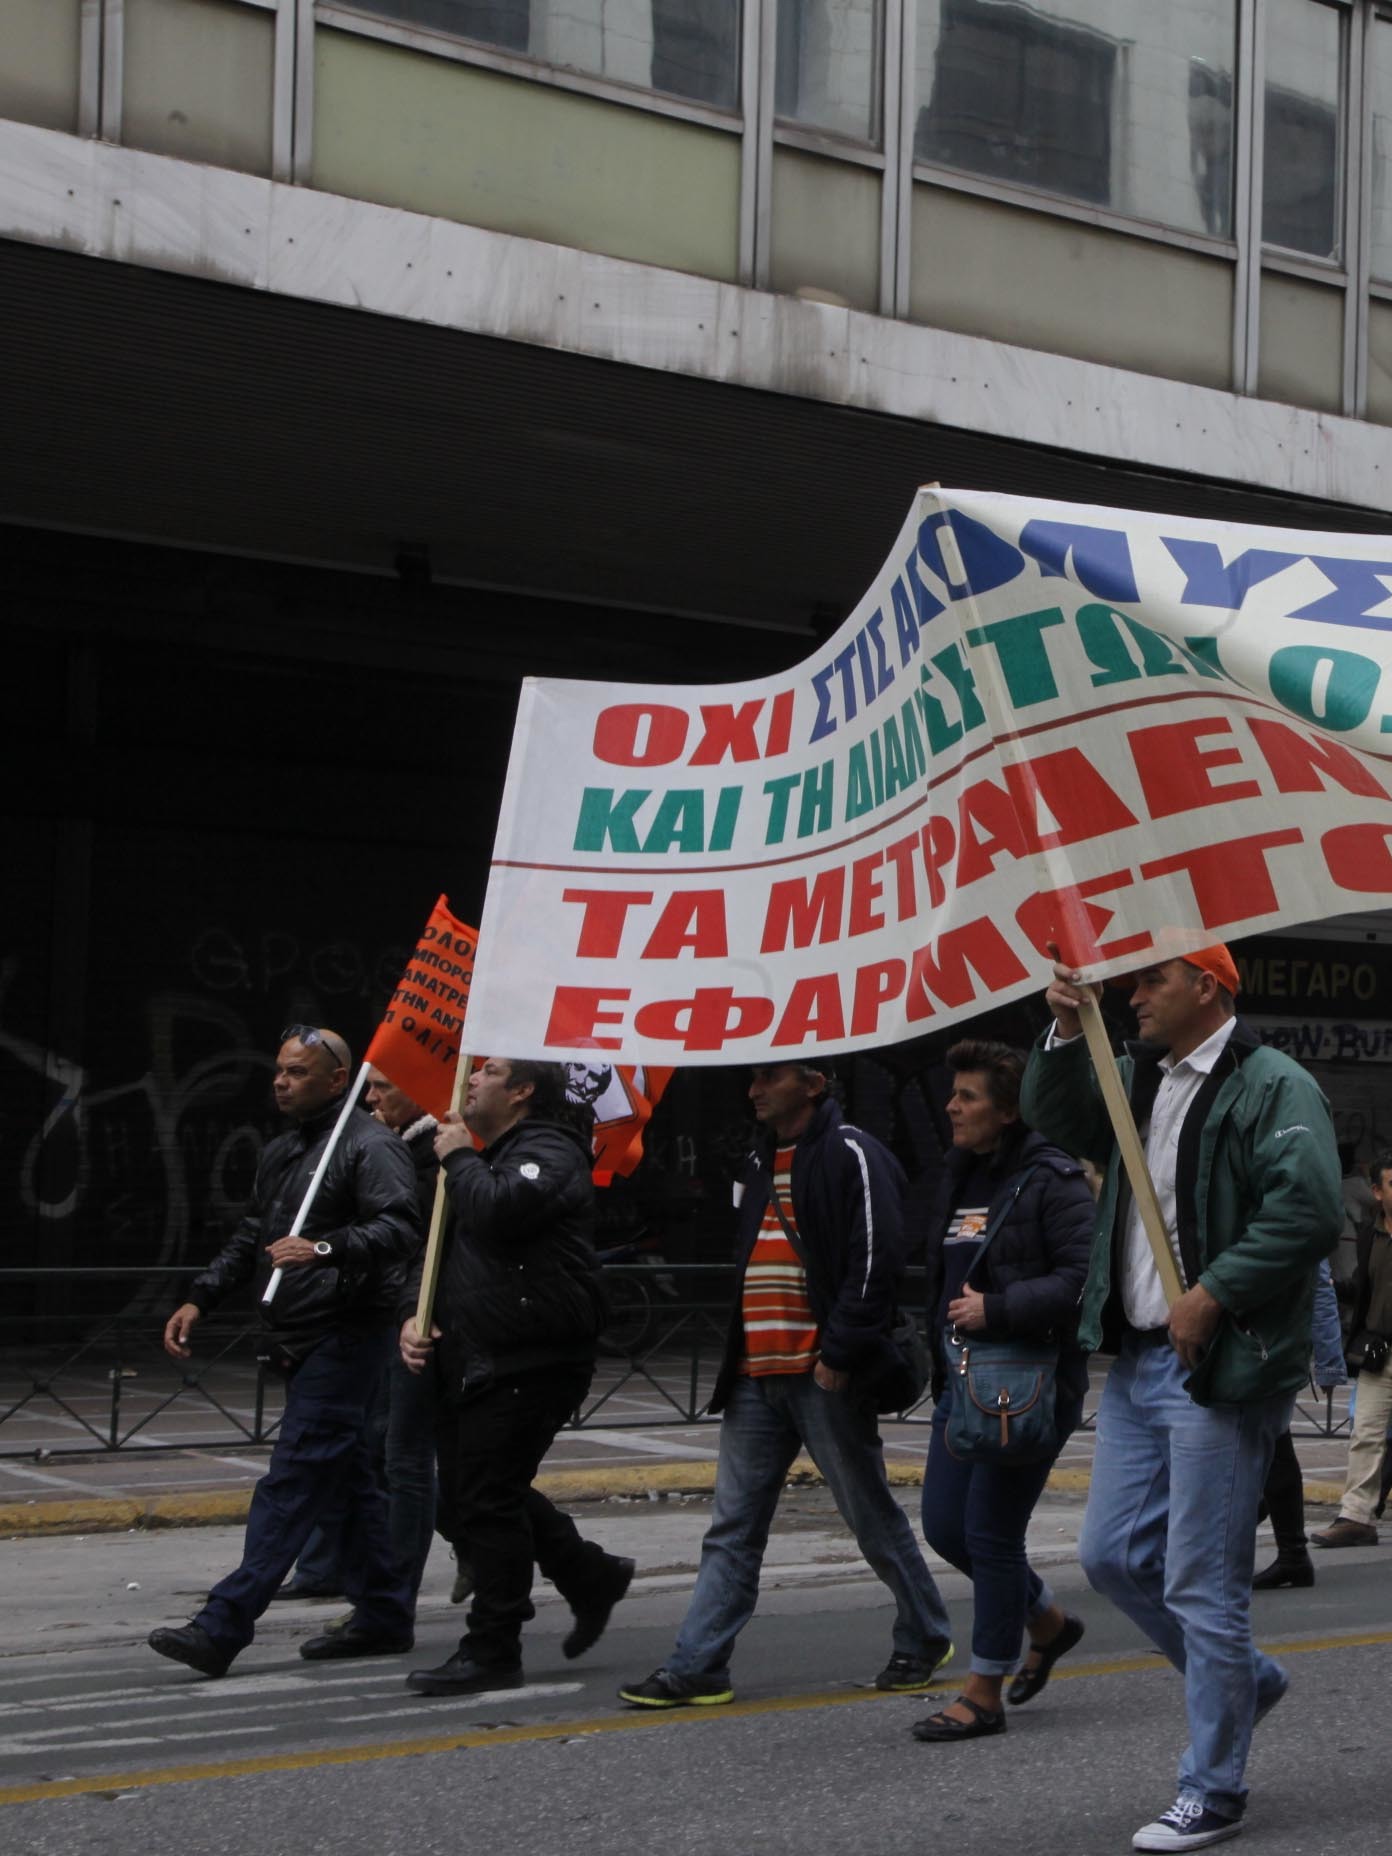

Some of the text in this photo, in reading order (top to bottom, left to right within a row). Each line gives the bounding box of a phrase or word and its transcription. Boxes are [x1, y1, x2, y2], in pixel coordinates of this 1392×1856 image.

[592, 689, 795, 767] ΟΧΙ
[808, 606, 896, 745] ΣΤΙΣ
[561, 888, 729, 960] ΤΑ
[759, 779, 1028, 955] ΜΕΤΡΑ
[572, 785, 743, 854] ΚΑΙ
[763, 758, 835, 846] ΤΗ
